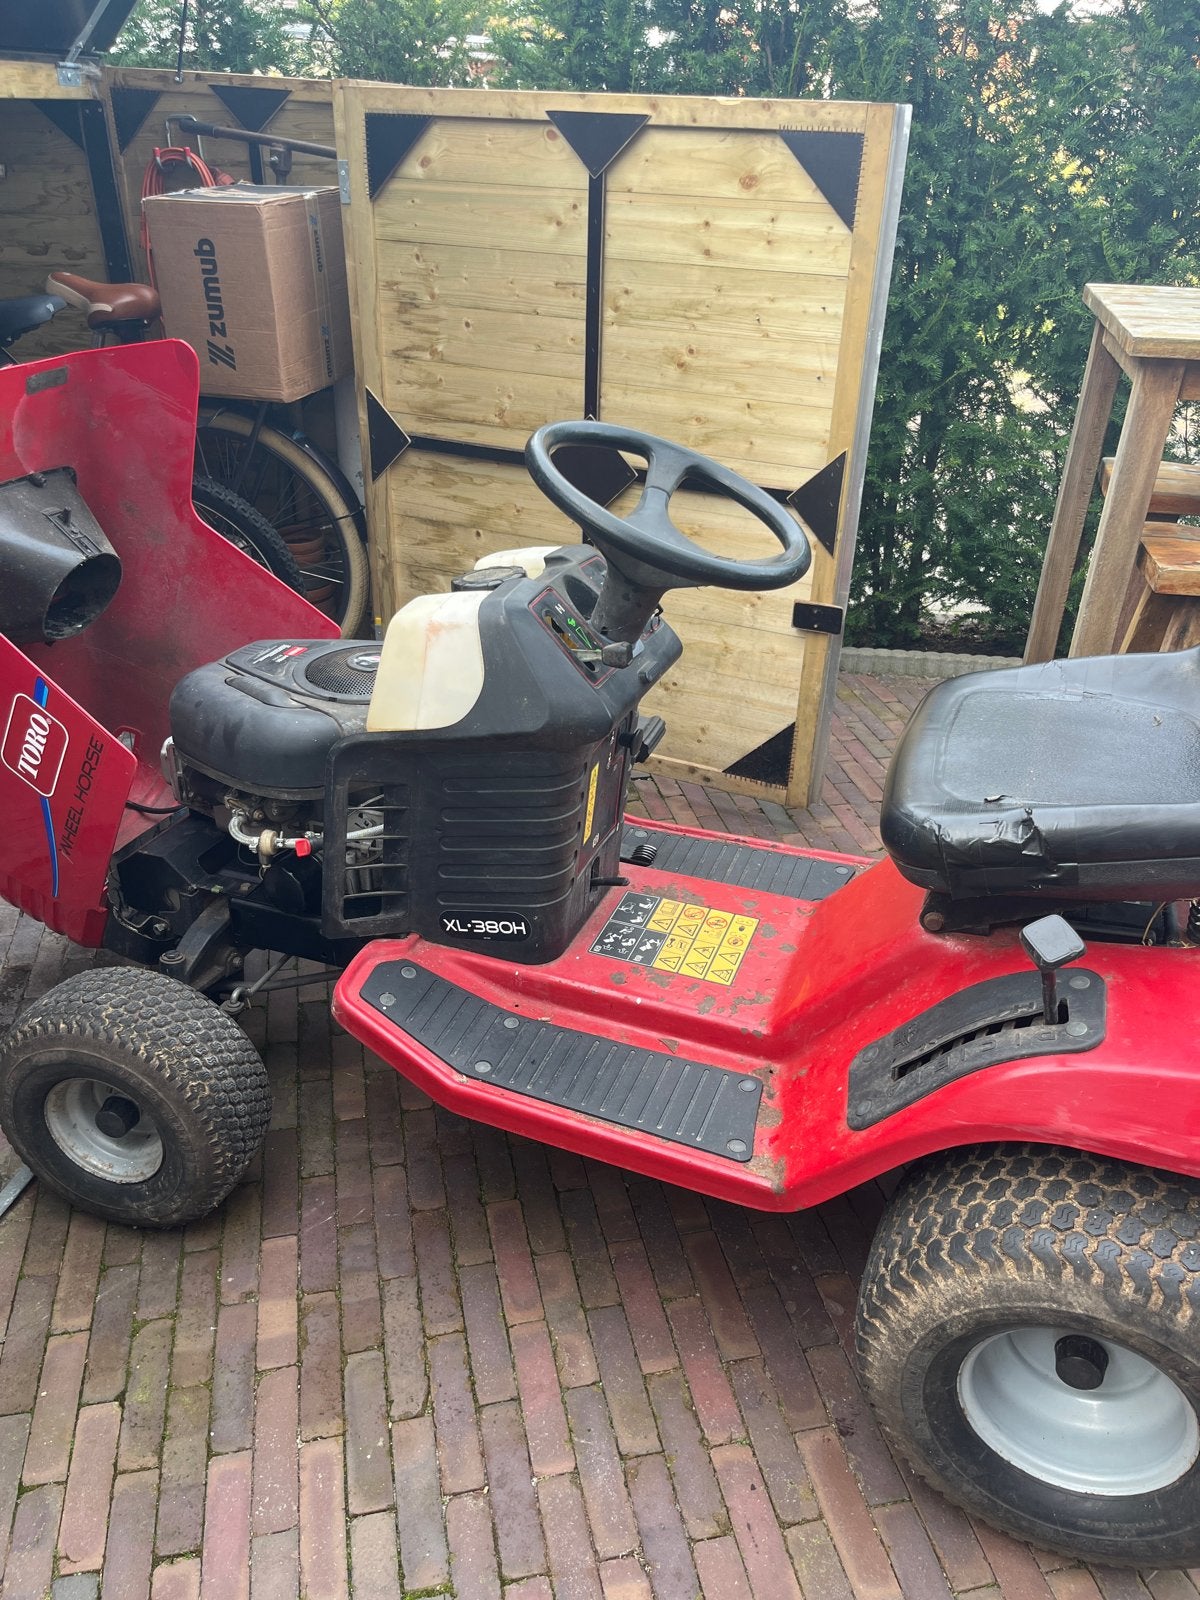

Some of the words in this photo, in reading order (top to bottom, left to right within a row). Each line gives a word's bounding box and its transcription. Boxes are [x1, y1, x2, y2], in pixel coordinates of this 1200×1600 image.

[193, 238, 228, 338] zumub
[17, 713, 51, 779] TORO
[58, 806, 84, 857] WHEEL
[74, 738, 105, 804] HORSE
